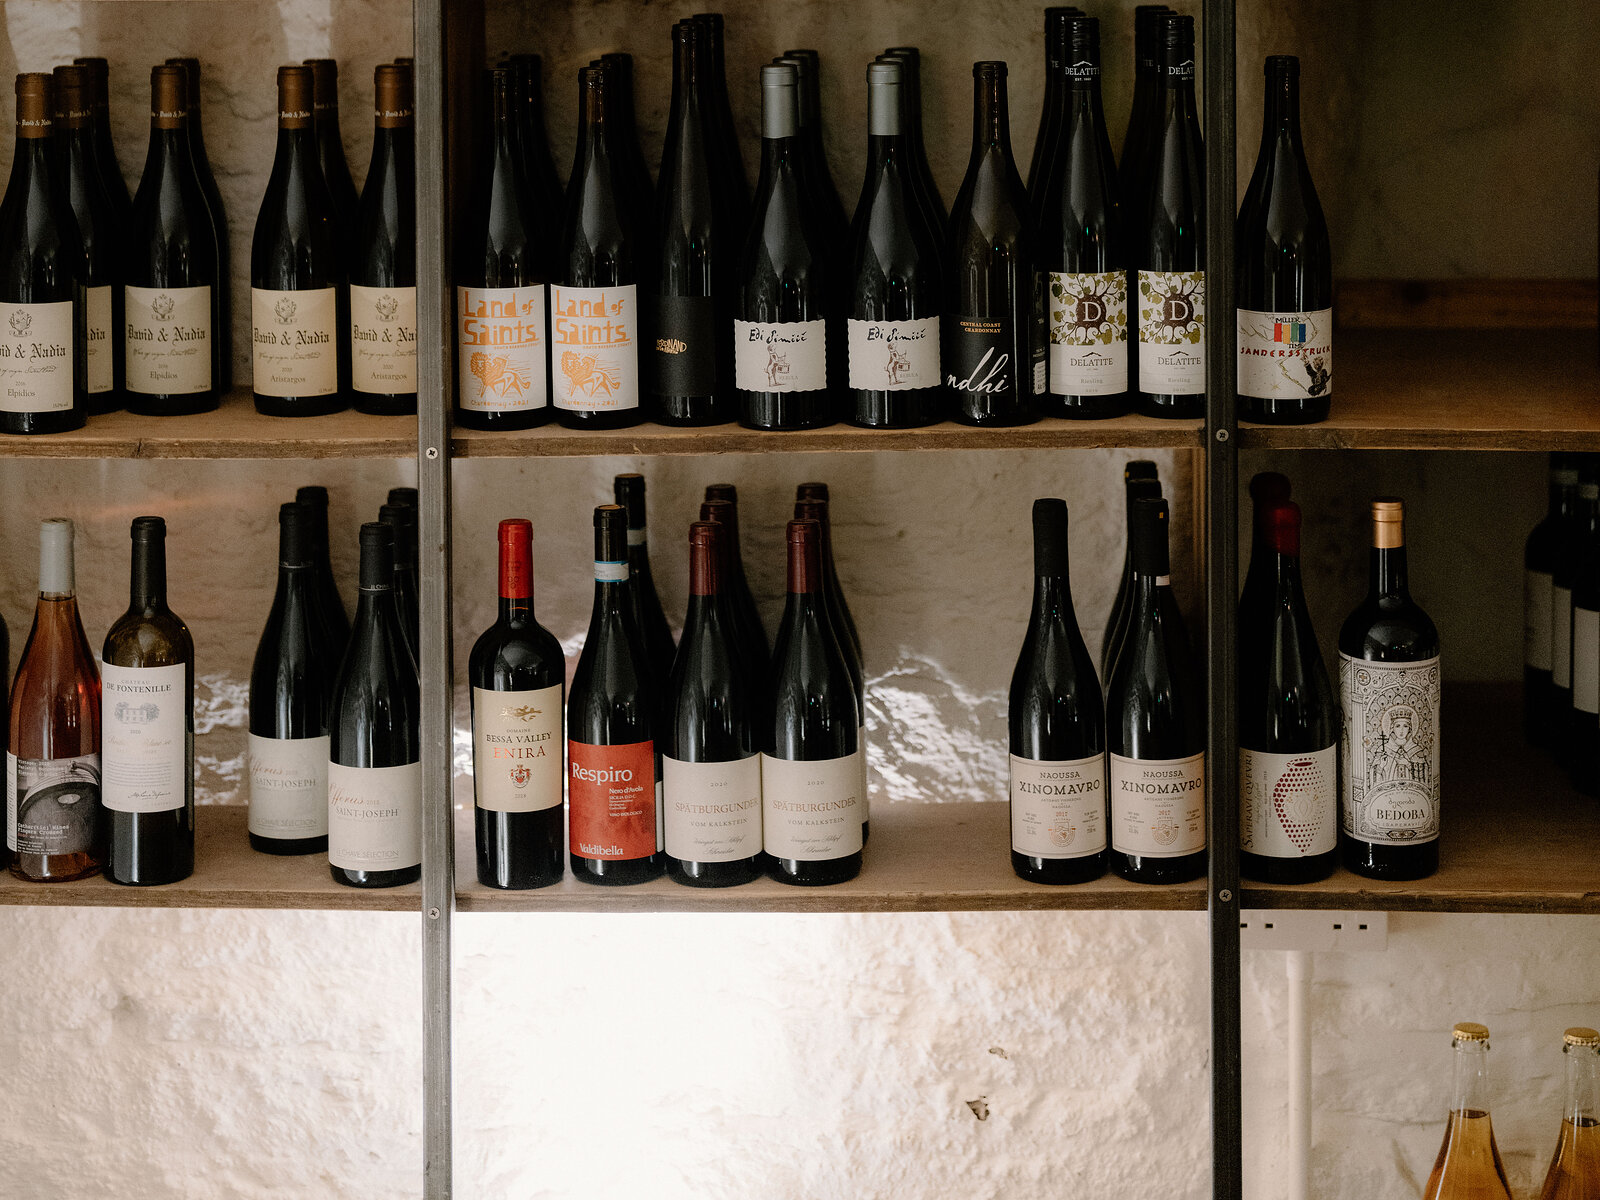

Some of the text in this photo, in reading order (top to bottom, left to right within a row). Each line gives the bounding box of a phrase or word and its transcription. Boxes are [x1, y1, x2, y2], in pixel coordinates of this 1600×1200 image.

[464, 290, 535, 317] Land of
[556, 289, 625, 317] Land of
[1082, 301, 1102, 322] D
[1169, 300, 1189, 321] D
[128, 324, 206, 346] David & Nadia
[354, 324, 393, 344] David &
[464, 318, 539, 345] Saints
[556, 318, 628, 345] Saints
[749, 327, 764, 342] Edi
[867, 326, 885, 341] Edi
[254, 327, 330, 350] David & Nadia
[14, 343, 66, 363] & Nadia
[1070, 357, 1114, 367] DELATITE
[1158, 357, 1201, 366] DELATITE
[150, 371, 178, 380] Elpidios
[370, 371, 408, 382] Aristargos
[947, 346, 1010, 394] ndhi
[270, 374, 306, 385] Aristargos
[7, 388, 36, 398] Elpidios
[470, 399, 507, 408] Chardonnay
[562, 399, 596, 408] Chardonnay
[106, 682, 172, 693] DE FONTENILLE
[486, 732, 552, 743] BESSA VALLEY
[493, 746, 546, 759] ENIRA
[572, 762, 633, 786] Respiro
[1039, 771, 1080, 779] NAOUSSA
[1143, 770, 1184, 778] NAOUSSA
[255, 777, 316, 788] SAINT-JOSEPH
[1019, 779, 1101, 795] XINOMAVRO
[1121, 778, 1202, 794] XINOMAVRO
[623, 786, 644, 794] d'Avola
[675, 797, 759, 814] SPÄTBURGUNDER
[772, 796, 856, 813] SPÄTBURGUNDER
[1243, 754, 1254, 848] SAPERAVI QVEVRI
[335, 807, 399, 818] SAINT-JOSEPH
[1376, 809, 1425, 820] BEDOBA
[709, 818, 748, 828] KALKSTEIN
[805, 817, 845, 826] KALKSTEIN
[580, 843, 624, 855] Valdibella
